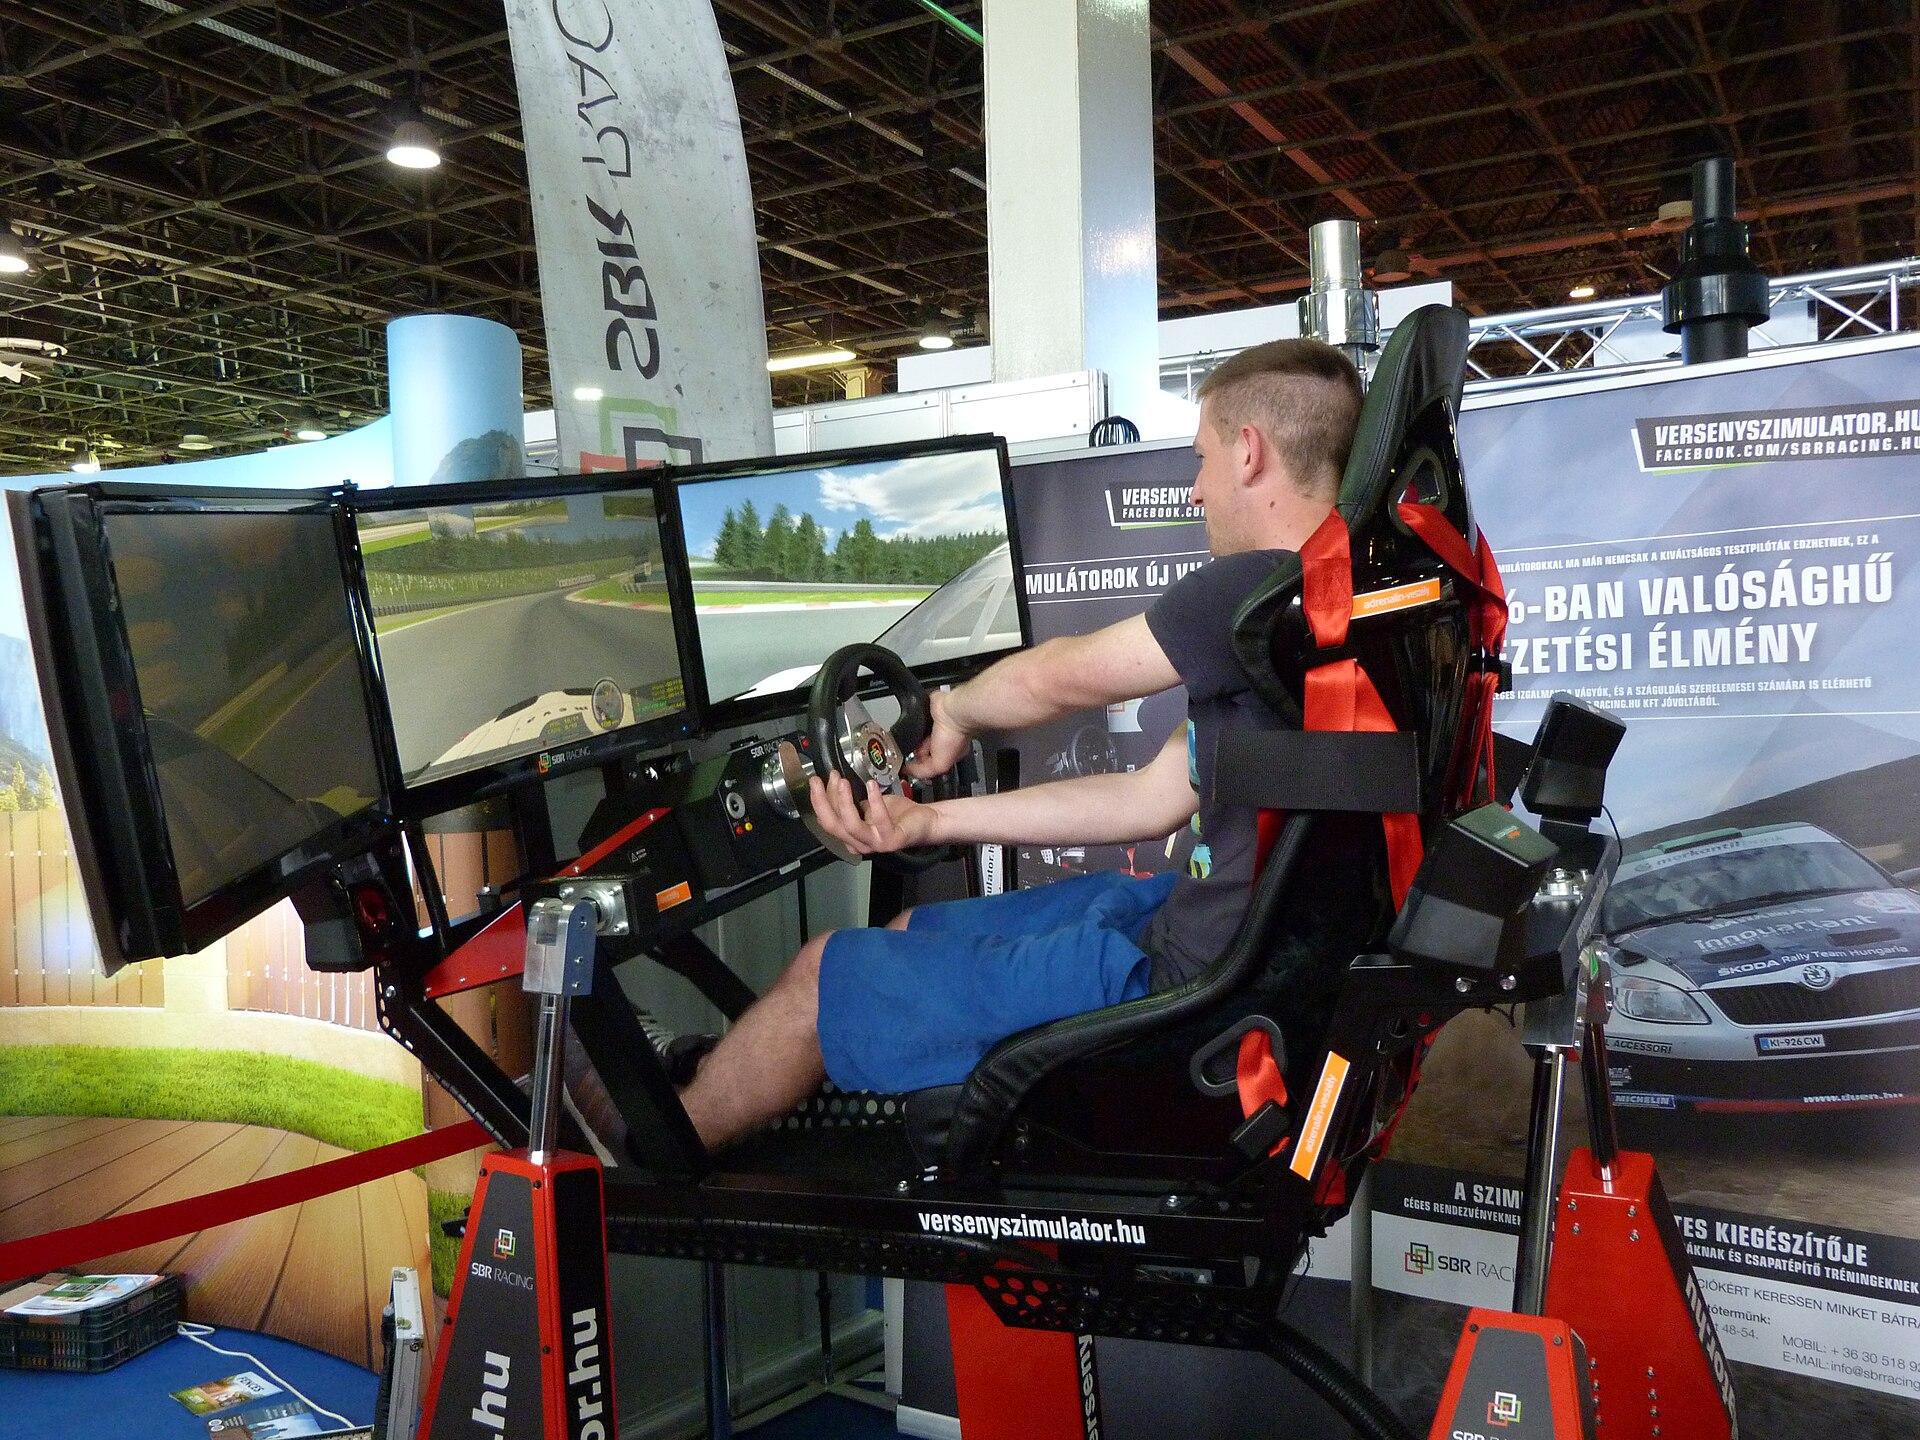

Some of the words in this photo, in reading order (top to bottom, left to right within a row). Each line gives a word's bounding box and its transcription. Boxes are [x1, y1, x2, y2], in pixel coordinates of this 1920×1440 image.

[1655, 409, 1920, 446] VERSENYSZIMULATOR.HU
[1655, 436, 1920, 462] FACEBOOK.COM/SBRRACING.HU
[1565, 560, 1580, 569] MA
[1582, 555, 1603, 567] MÁR
[1605, 552, 1649, 564] NEMCSAK
[1651, 552, 1657, 561] A
[1660, 546, 1722, 561] KIVÁLTSÁGOS
[1724, 540, 1791, 554] TESZTPILÓTÁK
[1857, 534, 1869, 545] EZ
[1871, 534, 1879, 544] A
[1026, 567, 1139, 594] MULÁTOROK
[1146, 560, 1169, 587] ÚJ
[1638, 551, 1895, 616] VALÓSÁGHŰ
[1649, 616, 1818, 669] ÉLMÉNY
[1614, 686, 1623, 696] ÉS
[1626, 687, 1633, 696] A
[1635, 684, 1687, 696] SZÁGULDÁS
[1689, 682, 1755, 695] SZERELEMESEI
[1758, 679, 1806, 692] SZÁMÁRA
[1809, 679, 1818, 690] IS
[1822, 677, 1873, 689] ELÉRHETŐ
[1643, 698, 1659, 708] KFT
[1717, 958, 1780, 977] ŠKODA
[1781, 952, 1810, 964] Rally
[1813, 950, 1847, 960] Team
[1849, 945, 1909, 957] Hungaria
[1770, 1037, 1802, 1047] KI-926
[1804, 1036, 1821, 1046] CW
[1615, 1095, 1670, 1105] MICHELIN
[1403, 1197, 1430, 1211] CÉGES
[1454, 1182, 1467, 1201] A
[1473, 1184, 1523, 1209] SZIM
[918, 1212, 1146, 1244] versenyszimulator.hu
[1715, 1221, 1868, 1267] KIEGÉSZÍTŐJE
[471, 1262, 492, 1280] SBR
[493, 1267, 534, 1290] RACING
[1437, 1255, 1472, 1275] SBR
[1728, 1249, 1742, 1263] ÉS
[1745, 1253, 1821, 1277] CSAPATÉPÍTŐ
[1825, 1267, 1919, 1294] TRÉNINGEKNEK
[1753, 1289, 1823, 1311] KERESSEN
[1827, 1302, 1877, 1321] MINKET
[1782, 1334, 1827, 1354] MOBIL:
[1842, 1347, 1858, 1360] 36
[1862, 1351, 1878, 1364] 30
[1881, 1355, 1905, 1370] 518
[1782, 1351, 1829, 1371] E-MAIL:
[1831, 1361, 1920, 1391] info@sbrracing
